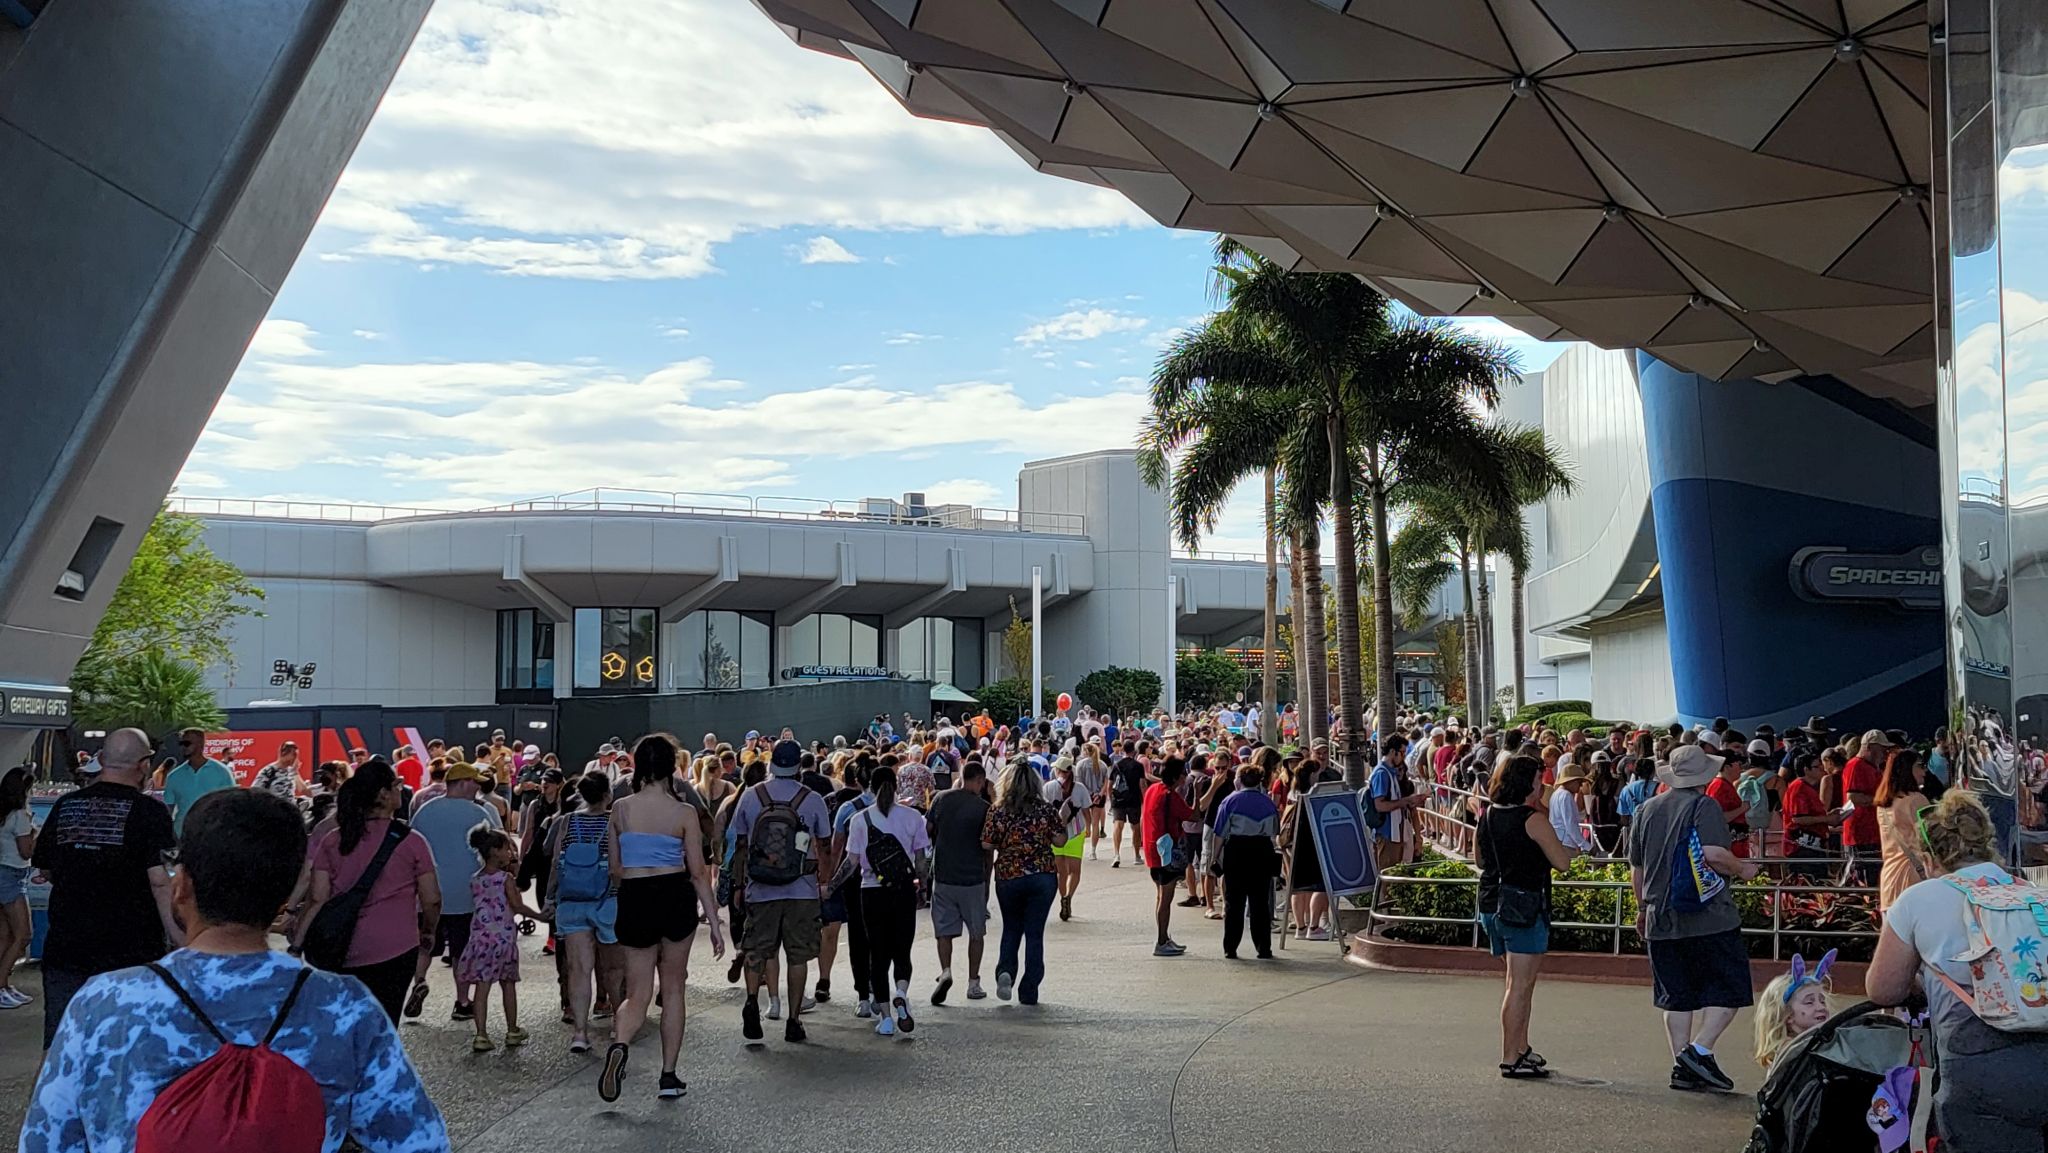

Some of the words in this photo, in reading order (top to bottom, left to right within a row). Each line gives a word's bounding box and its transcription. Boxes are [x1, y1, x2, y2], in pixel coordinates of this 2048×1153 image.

[1829, 567, 1940, 585] SPACESHI
[803, 665, 835, 675] GUEST
[836, 666, 887, 676] RELATIONS
[11, 696, 46, 715] GATEWAY
[47, 698, 67, 716] GIFTS
[241, 738, 254, 746] OF
